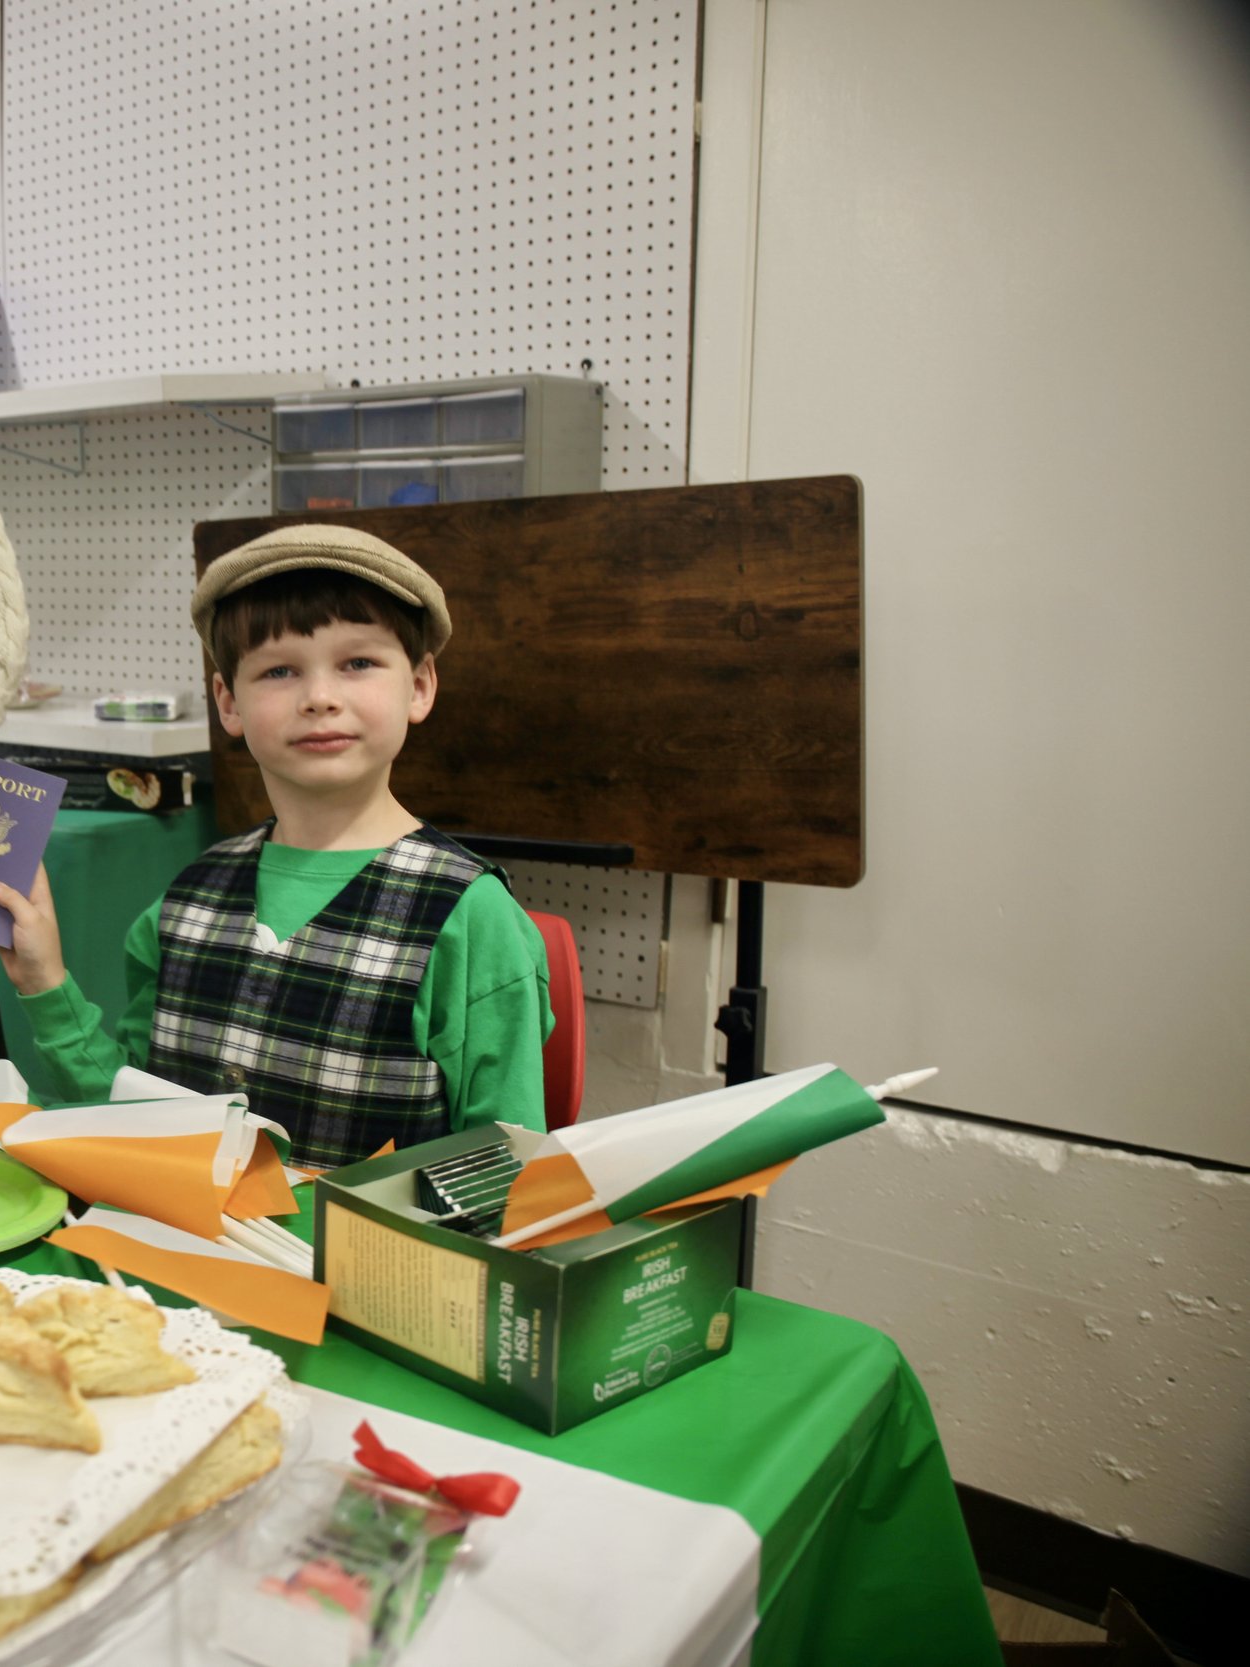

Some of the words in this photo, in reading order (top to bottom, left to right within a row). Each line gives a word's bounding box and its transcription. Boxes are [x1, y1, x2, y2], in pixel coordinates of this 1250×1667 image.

[622, 1265, 688, 1304] BREAKFAST
[642, 1255, 671, 1279] IRISH
[496, 1280, 515, 1385] BREAKFAST
[513, 1316, 530, 1363] IRISH
